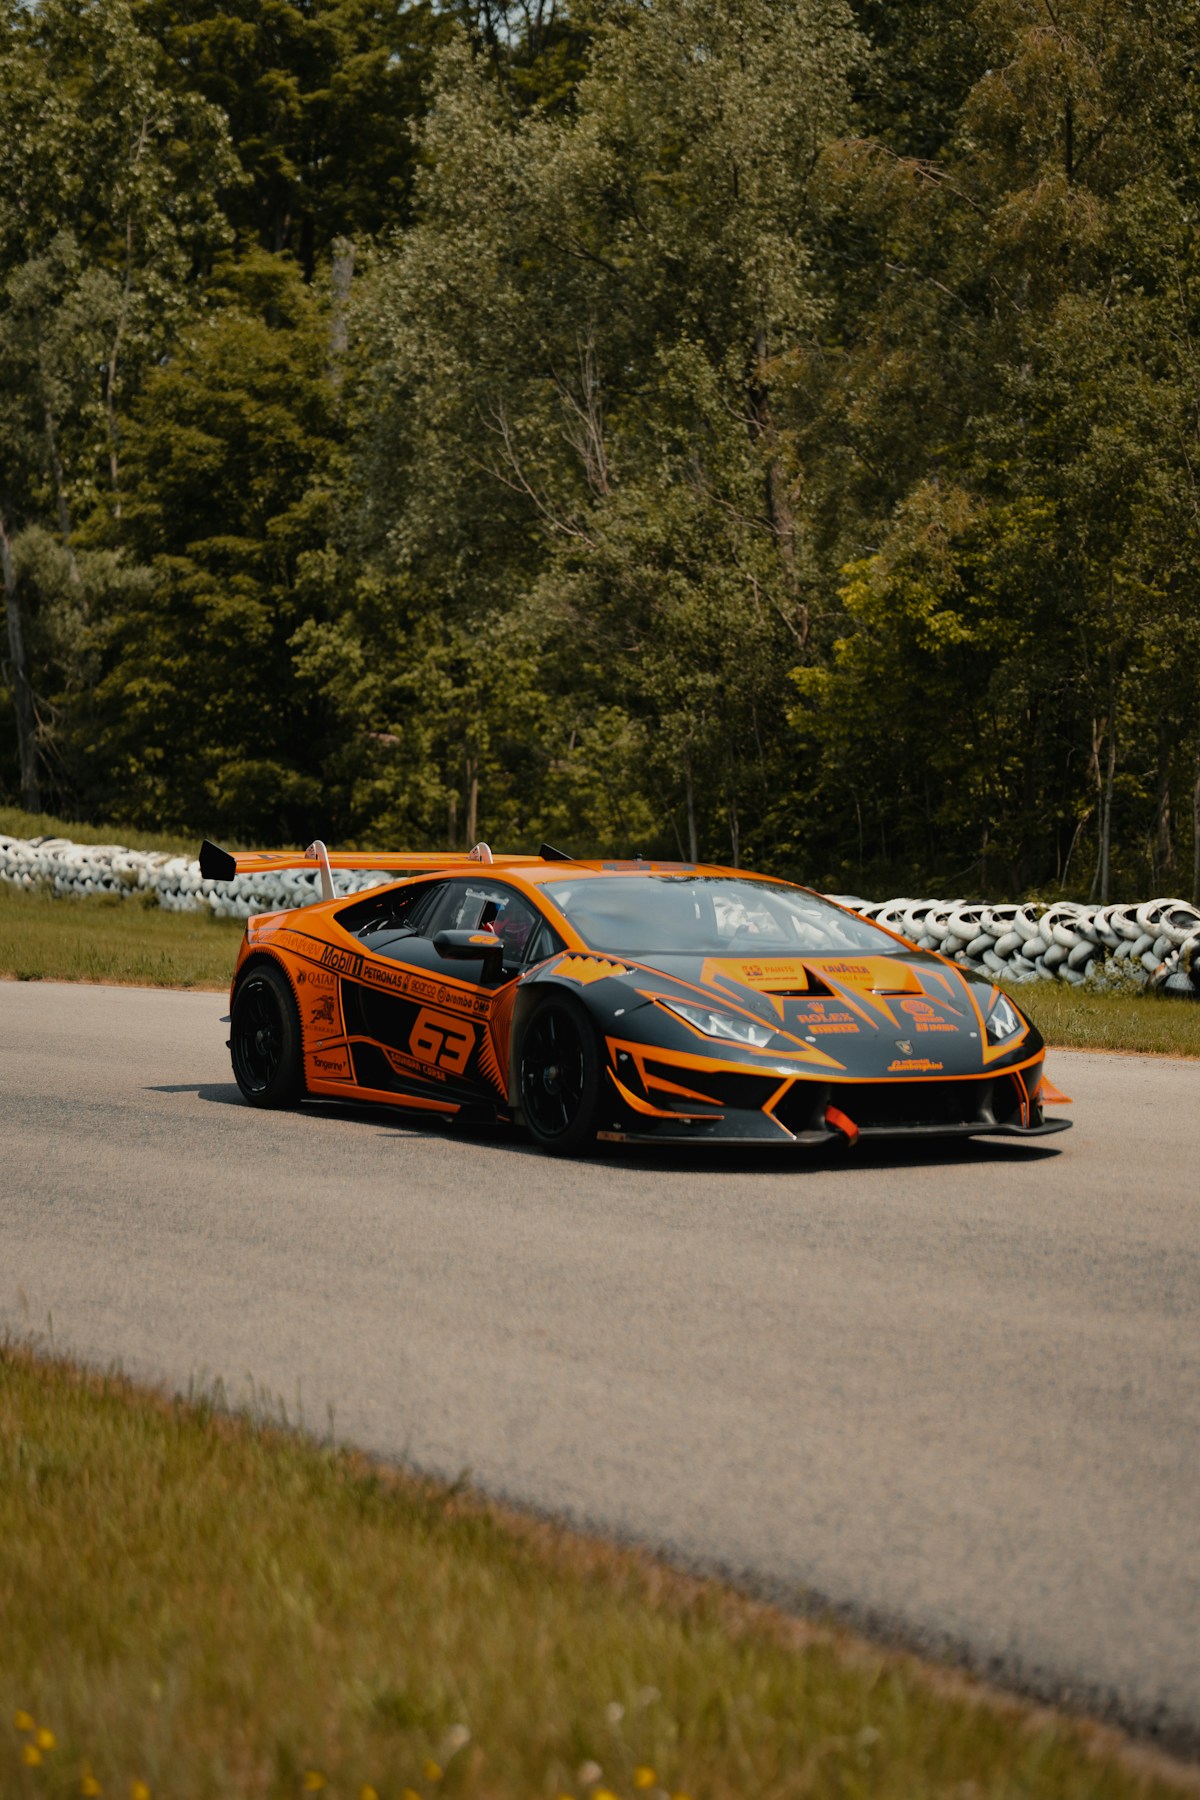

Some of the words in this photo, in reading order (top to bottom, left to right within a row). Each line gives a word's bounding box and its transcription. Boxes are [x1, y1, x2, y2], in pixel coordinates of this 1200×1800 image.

[320, 945, 354, 972] Mobil
[308, 972, 335, 986] QATAR
[364, 966, 402, 987] PETRONAS
[411, 979, 436, 996] sparco
[446, 991, 473, 1009] brembo
[797, 1012, 854, 1024] ROLEX
[409, 1006, 476, 1075] 63
[313, 1055, 343, 1072] Tangerine
